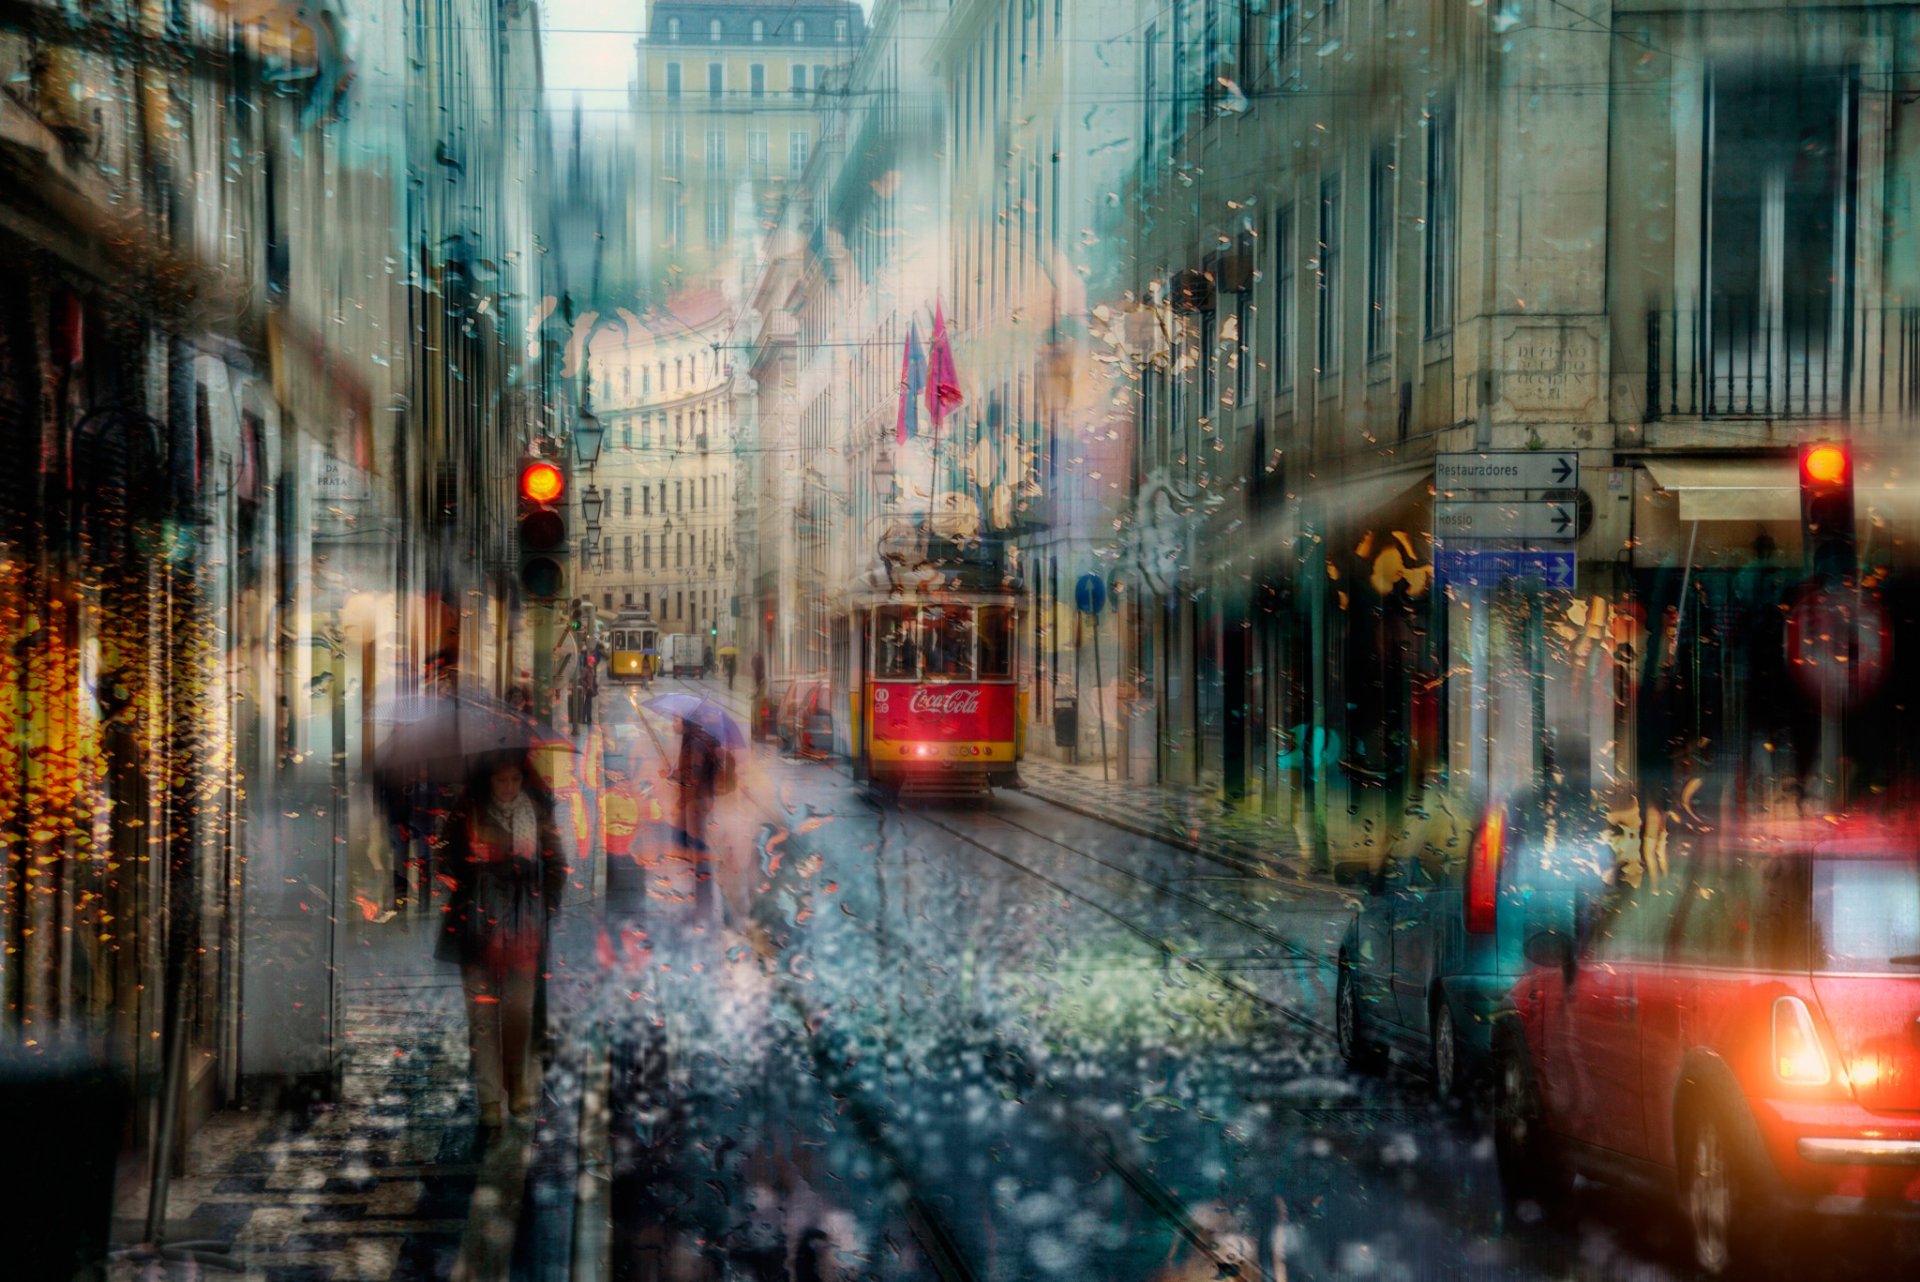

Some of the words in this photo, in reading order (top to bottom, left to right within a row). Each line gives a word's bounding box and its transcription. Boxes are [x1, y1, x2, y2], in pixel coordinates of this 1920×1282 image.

[326, 465, 339, 473] DA
[1438, 463, 1518, 476] Restauradores
[318, 477, 347, 486] PRATA
[909, 689, 982, 714] Coca-Cola
